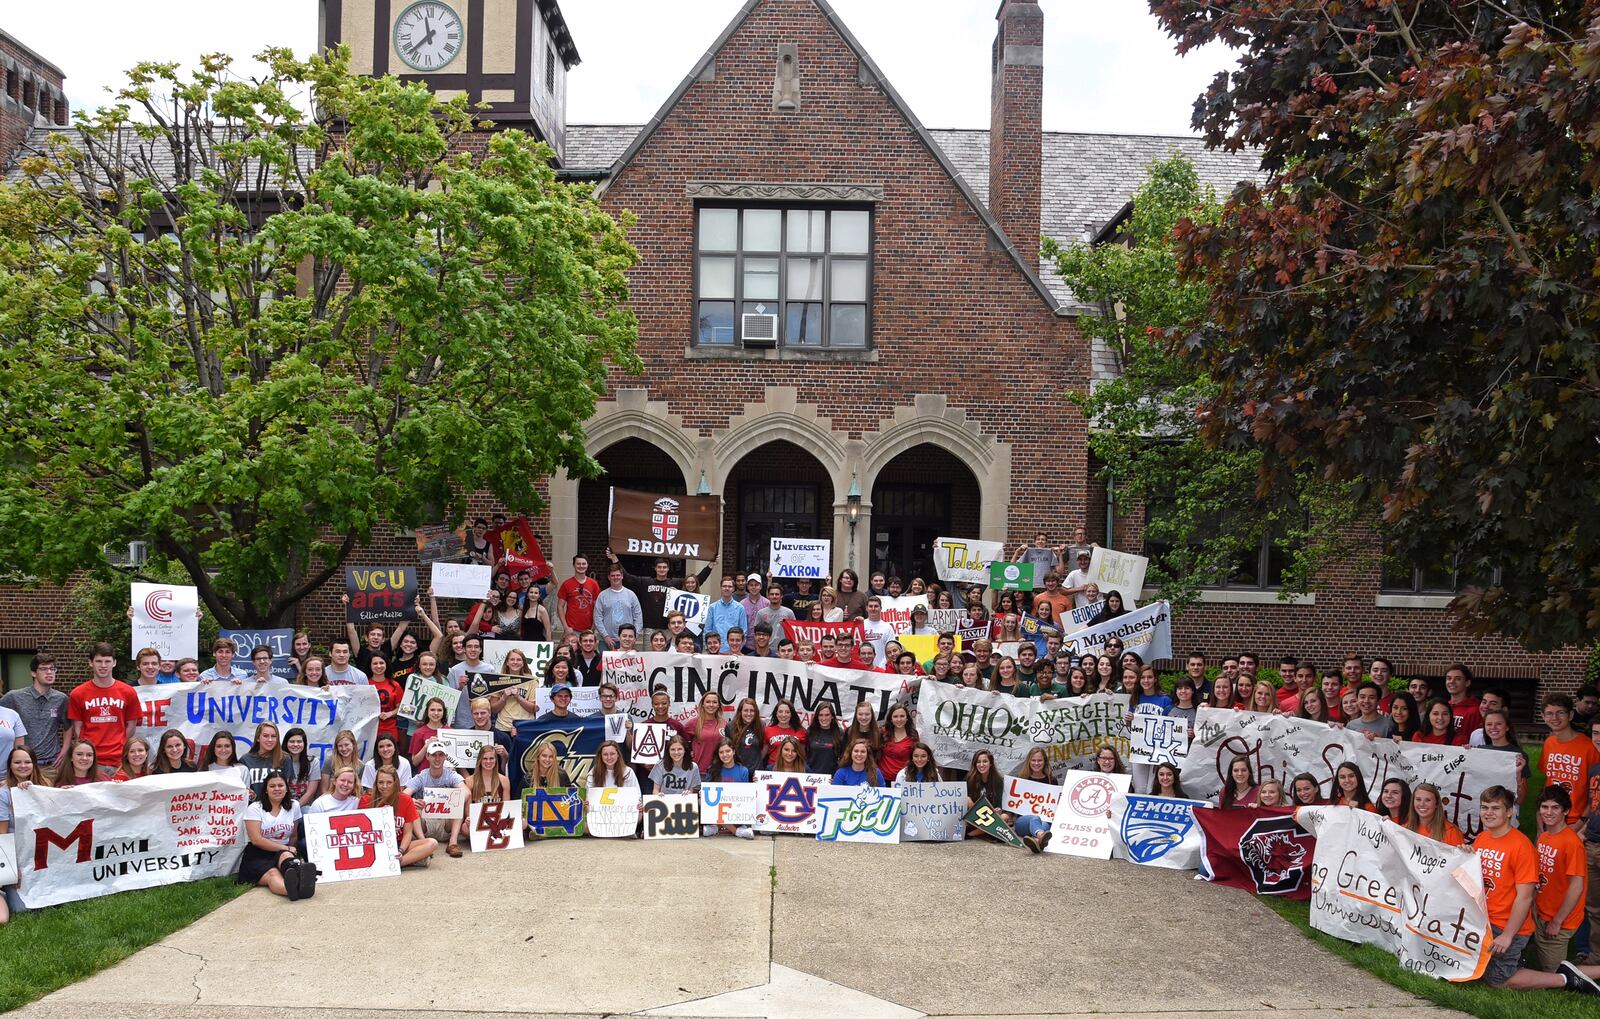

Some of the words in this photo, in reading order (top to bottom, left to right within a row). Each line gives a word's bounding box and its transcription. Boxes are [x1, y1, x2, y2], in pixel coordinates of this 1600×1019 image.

[627, 538, 699, 557] BROWN
[773, 541, 825, 552] UNIVERSITY
[791, 553, 806, 564] OF
[941, 542, 984, 571] Toledo
[778, 564, 820, 577] AKRON
[352, 570, 405, 590] VCU
[351, 587, 406, 609] arts
[678, 596, 698, 617] FIT
[1082, 613, 1168, 648] Manchester
[150, 641, 171, 656] Molly
[606, 656, 645, 672] Henry
[606, 671, 647, 684] Michael
[617, 688, 649, 704] hayna
[648, 667, 893, 721] CINCINNATI
[85, 697, 125, 710] MIAMI
[187, 691, 339, 725] UNIVERSITY
[935, 700, 1013, 738] OHIO
[1036, 702, 1125, 724] WRIGHT
[1239, 715, 1257, 729] Brett
[933, 726, 1016, 748] UNIVERSITY
[1055, 718, 1117, 744] STATE
[1198, 720, 1226, 743] The
[1283, 743, 1300, 757] Sally
[1421, 753, 1445, 763] Elliott
[1443, 753, 1466, 774] Elise
[1548, 753, 1582, 767] BGSU
[1546, 763, 1580, 775] CLASS
[663, 773, 688, 789] Pitt
[929, 781, 962, 797] Louis
[170, 793, 200, 803] ADAM
[209, 789, 244, 802] JASMINE
[1009, 779, 1056, 804] Loyola
[170, 803, 194, 812] ABBY
[208, 804, 235, 815] Hollis
[717, 803, 756, 823] FLORIDA
[900, 801, 964, 821] University
[1008, 800, 1022, 809] of
[643, 800, 698, 837] Pitt
[816, 793, 901, 840] FGCU
[1131, 812, 1192, 822] EAGLES
[1059, 823, 1093, 833] CLASS
[1095, 825, 1110, 834] OF
[215, 838, 236, 846] TROY
[329, 832, 384, 847] DENISON
[1061, 836, 1099, 847] 2020
[93, 849, 220, 882] UNIVERSITY
[1410, 844, 1447, 874] Maggie
[1337, 850, 1403, 907] Gree
[1407, 884, 1480, 951] State
[1423, 942, 1461, 970] Jason
